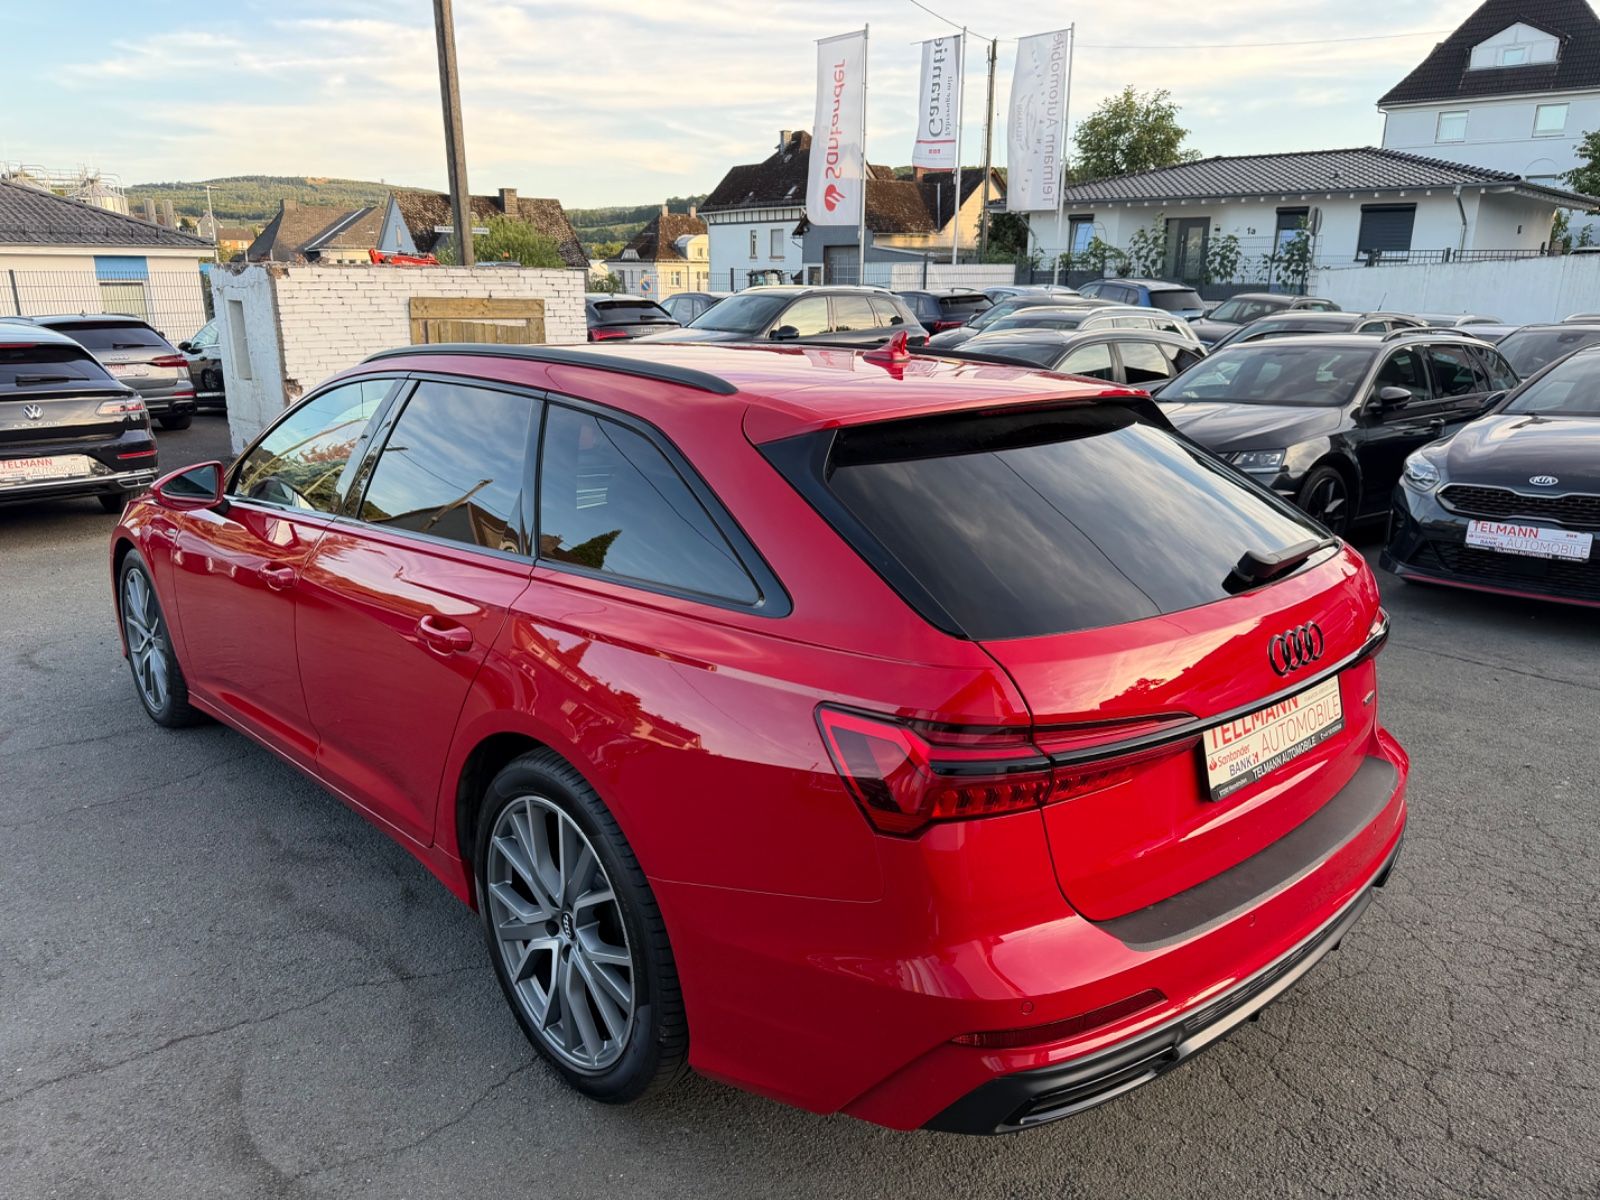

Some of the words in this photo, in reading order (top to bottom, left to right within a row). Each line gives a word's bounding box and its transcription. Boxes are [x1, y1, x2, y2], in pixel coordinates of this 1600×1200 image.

[1473, 520, 1539, 539] TELMANN
[1506, 539, 1589, 558] AUTOMOBILE
[1262, 694, 1340, 758] AUTOMOBILE
[1217, 744, 1249, 768] Santander
